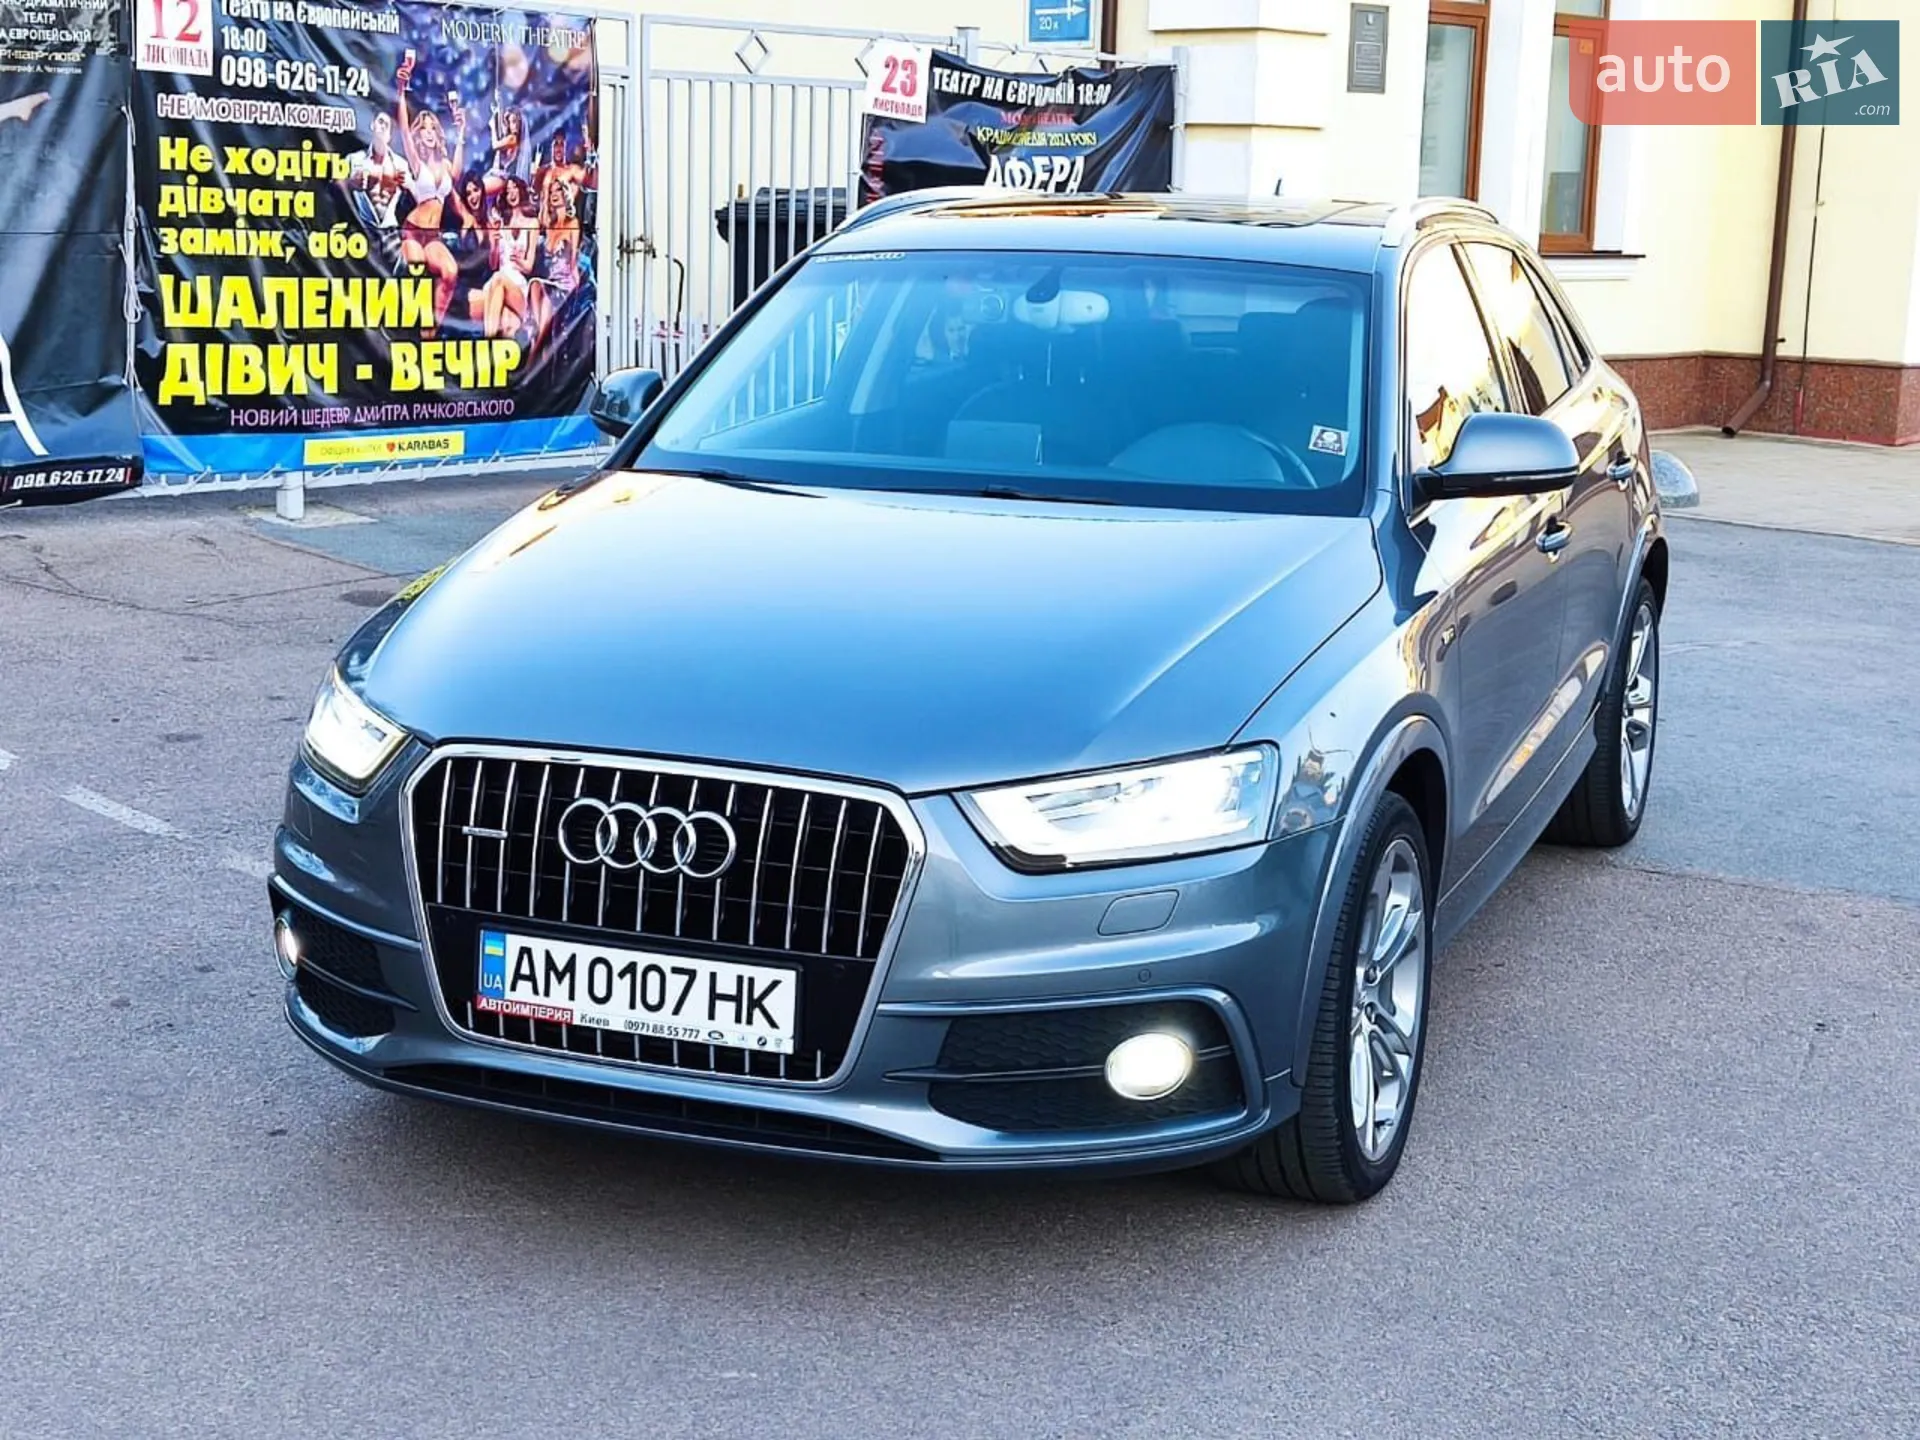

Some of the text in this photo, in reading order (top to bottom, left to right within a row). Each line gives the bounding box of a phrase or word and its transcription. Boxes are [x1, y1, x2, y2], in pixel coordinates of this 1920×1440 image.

[22, 11, 56, 24] ТЕАТР
[150, 0, 203, 42] 12
[220, 0, 400, 33] Театр на Європейській
[441, 18, 588, 49] MODERN THEATRE
[143, 44, 210, 67] ЛИСТОПАДА
[221, 27, 267, 52] 18:00
[220, 55, 370, 97] 098-626-17-24
[881, 56, 918, 97] 23
[932, 66, 982, 96] ТЕАТР
[981, 76, 1004, 102] НА
[157, 93, 356, 132] НЕЙМОВІРНА КОМЕДІЯ
[158, 136, 351, 182] Не ходіть
[982, 153, 1086, 195] АФЕРА
[158, 174, 316, 219] дівчата
[158, 216, 369, 264] заміж, або
[158, 262, 436, 329] ШАЛЕНИЙ
[157, 342, 340, 406] ДІВИЧ
[389, 339, 523, 393] ВЕЧІР
[229, 398, 516, 428] НОВИЙ ШЕДЕВР ДМИТРА РАЧКОВСЬКОГО
[397, 438, 450, 452] KARABAS
[484, 972, 504, 991] UA
[509, 945, 783, 1030] AM 0107 HK
[479, 998, 573, 1022] АВТОИМПЕРИЯ
[580, 1012, 610, 1028] Киев
[666, 1024, 680, 1036] 55
[681, 1026, 701, 1040] 777
